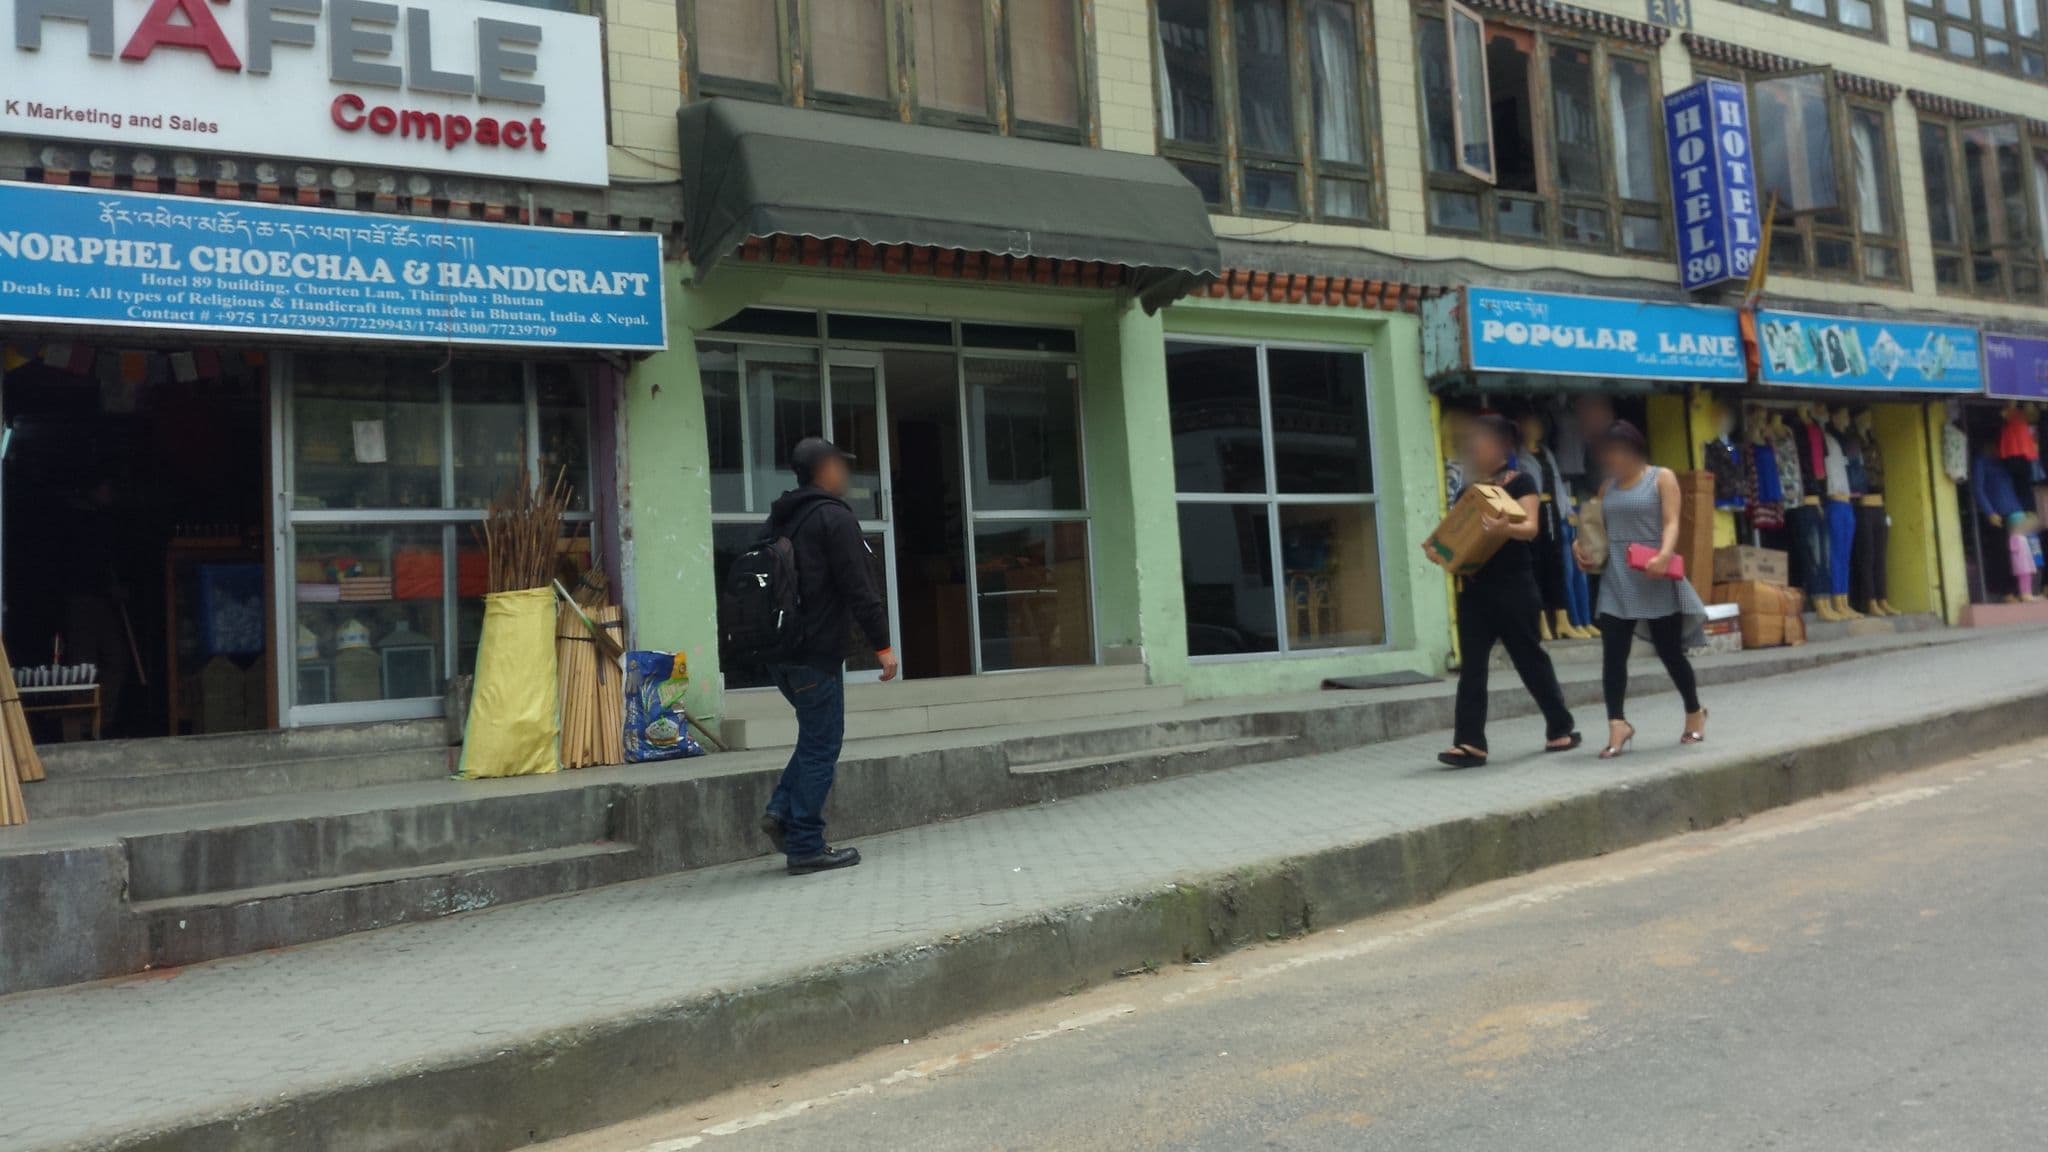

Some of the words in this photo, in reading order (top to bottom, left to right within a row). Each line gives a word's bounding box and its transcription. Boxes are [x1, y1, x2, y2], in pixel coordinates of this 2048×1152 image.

[27, 102, 122, 129] Marketing
[128, 113, 163, 129] and
[168, 116, 219, 134] Sales
[331, 93, 547, 151] Compact
[1674, 104, 1714, 255] HOTEL
[1719, 101, 1757, 245] HOTEL
[0, 230, 181, 271] NORPHEL
[188, 245, 396, 284] CHOECHAA
[402, 259, 431, 286] &
[437, 261, 650, 297] HANDICRAFT
[1687, 253, 1722, 284] 89
[2, 280, 52, 296] Deals
[57, 283, 81, 298] in:
[86, 286, 112, 300] All
[117, 288, 161, 305] types
[167, 290, 185, 304] of
[189, 291, 265, 309] Religious
[269, 296, 285, 310] &
[291, 298, 377, 314] Handicraft
[381, 303, 422, 318] items
[426, 306, 467, 319] made
[471, 307, 485, 319] in
[489, 308, 547, 323] Bhutan,
[550, 311, 587, 324] India
[589, 312, 603, 324] &
[606, 312, 649, 327] Nepal.
[141, 272, 187, 288] Hotel
[192, 276, 212, 288] 89
[217, 277, 290, 296] building,
[294, 281, 360, 298] Chorten
[364, 286, 405, 301] Lam,
[409, 288, 478, 306] Thimphu
[492, 293, 544, 307] Bhutan
[127, 305, 195, 321] Contact
[200, 307, 210, 321] #
[215, 310, 256, 325] +975
[1481, 319, 1639, 353] POPULAR
[1658, 331, 1738, 358] LANE
